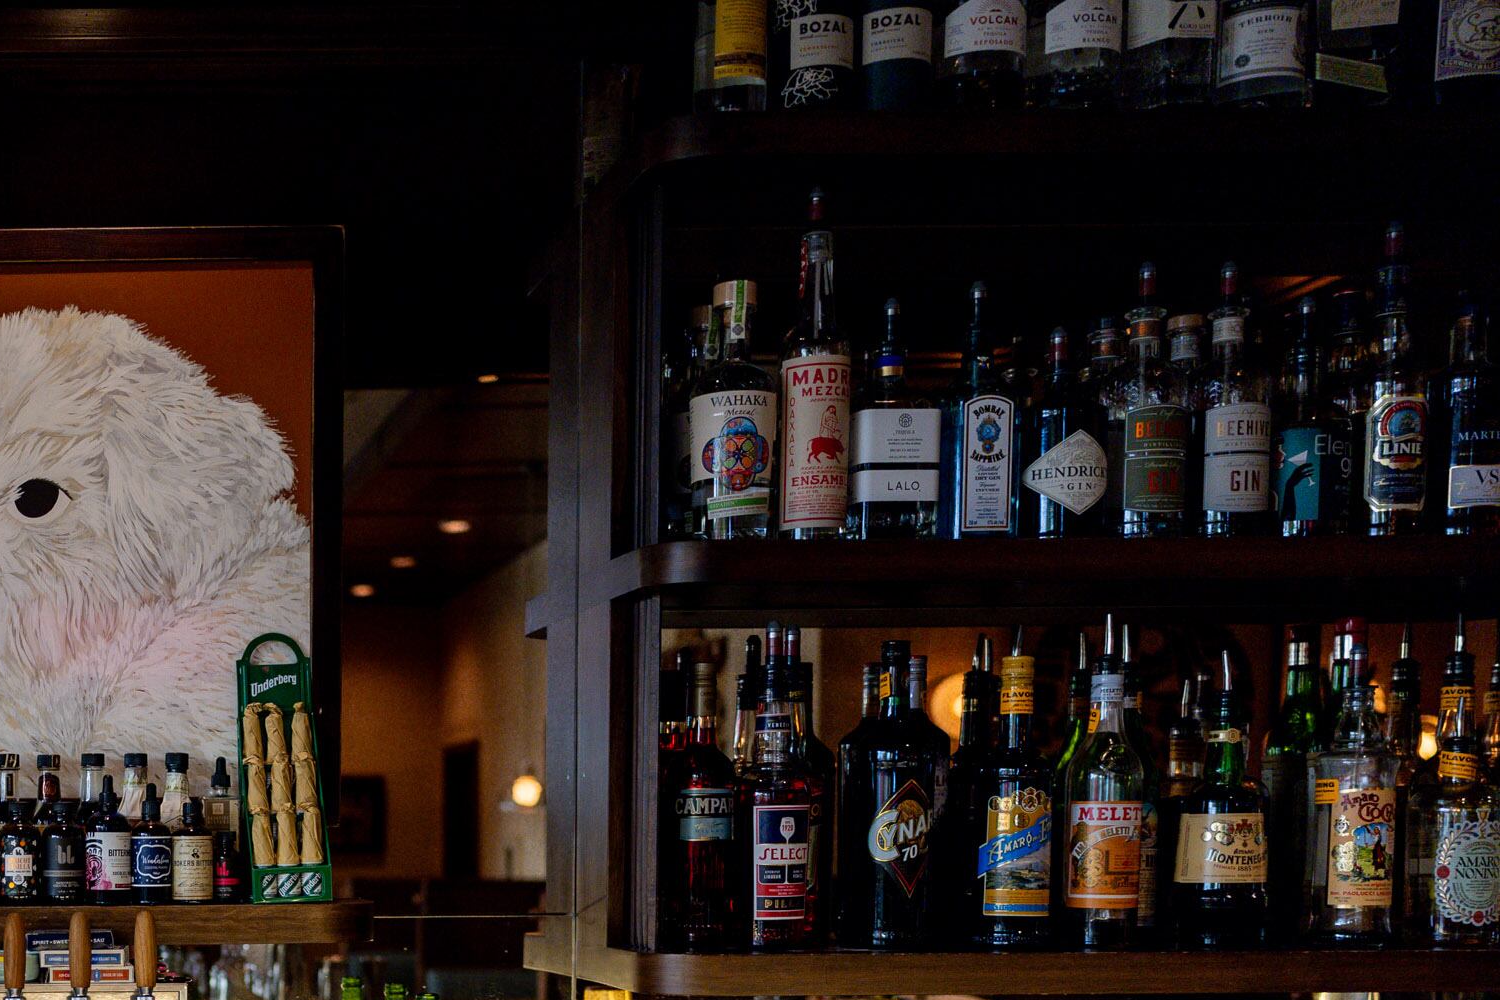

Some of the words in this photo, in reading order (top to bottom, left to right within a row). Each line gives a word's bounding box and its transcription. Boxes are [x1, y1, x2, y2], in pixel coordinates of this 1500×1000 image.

[871, 14, 922, 28] BOZAL
[970, 16, 1018, 26] VOLCAN
[1073, 13, 1117, 25] VOLCAN
[798, 21, 847, 35] BOZAL
[801, 385, 850, 397] MEZCA
[711, 394, 767, 407] WAHAKA
[724, 407, 756, 418] Mezcal
[973, 404, 1006, 419] BOMBAY
[970, 450, 1006, 464] SAPPHIRE
[887, 480, 920, 491] LALO
[1067, 482, 1093, 490] GIN
[1230, 470, 1261, 491] GIN
[250, 673, 298, 698] Underberg
[759, 847, 807, 860] SELECT
[902, 844, 919, 862] 70
